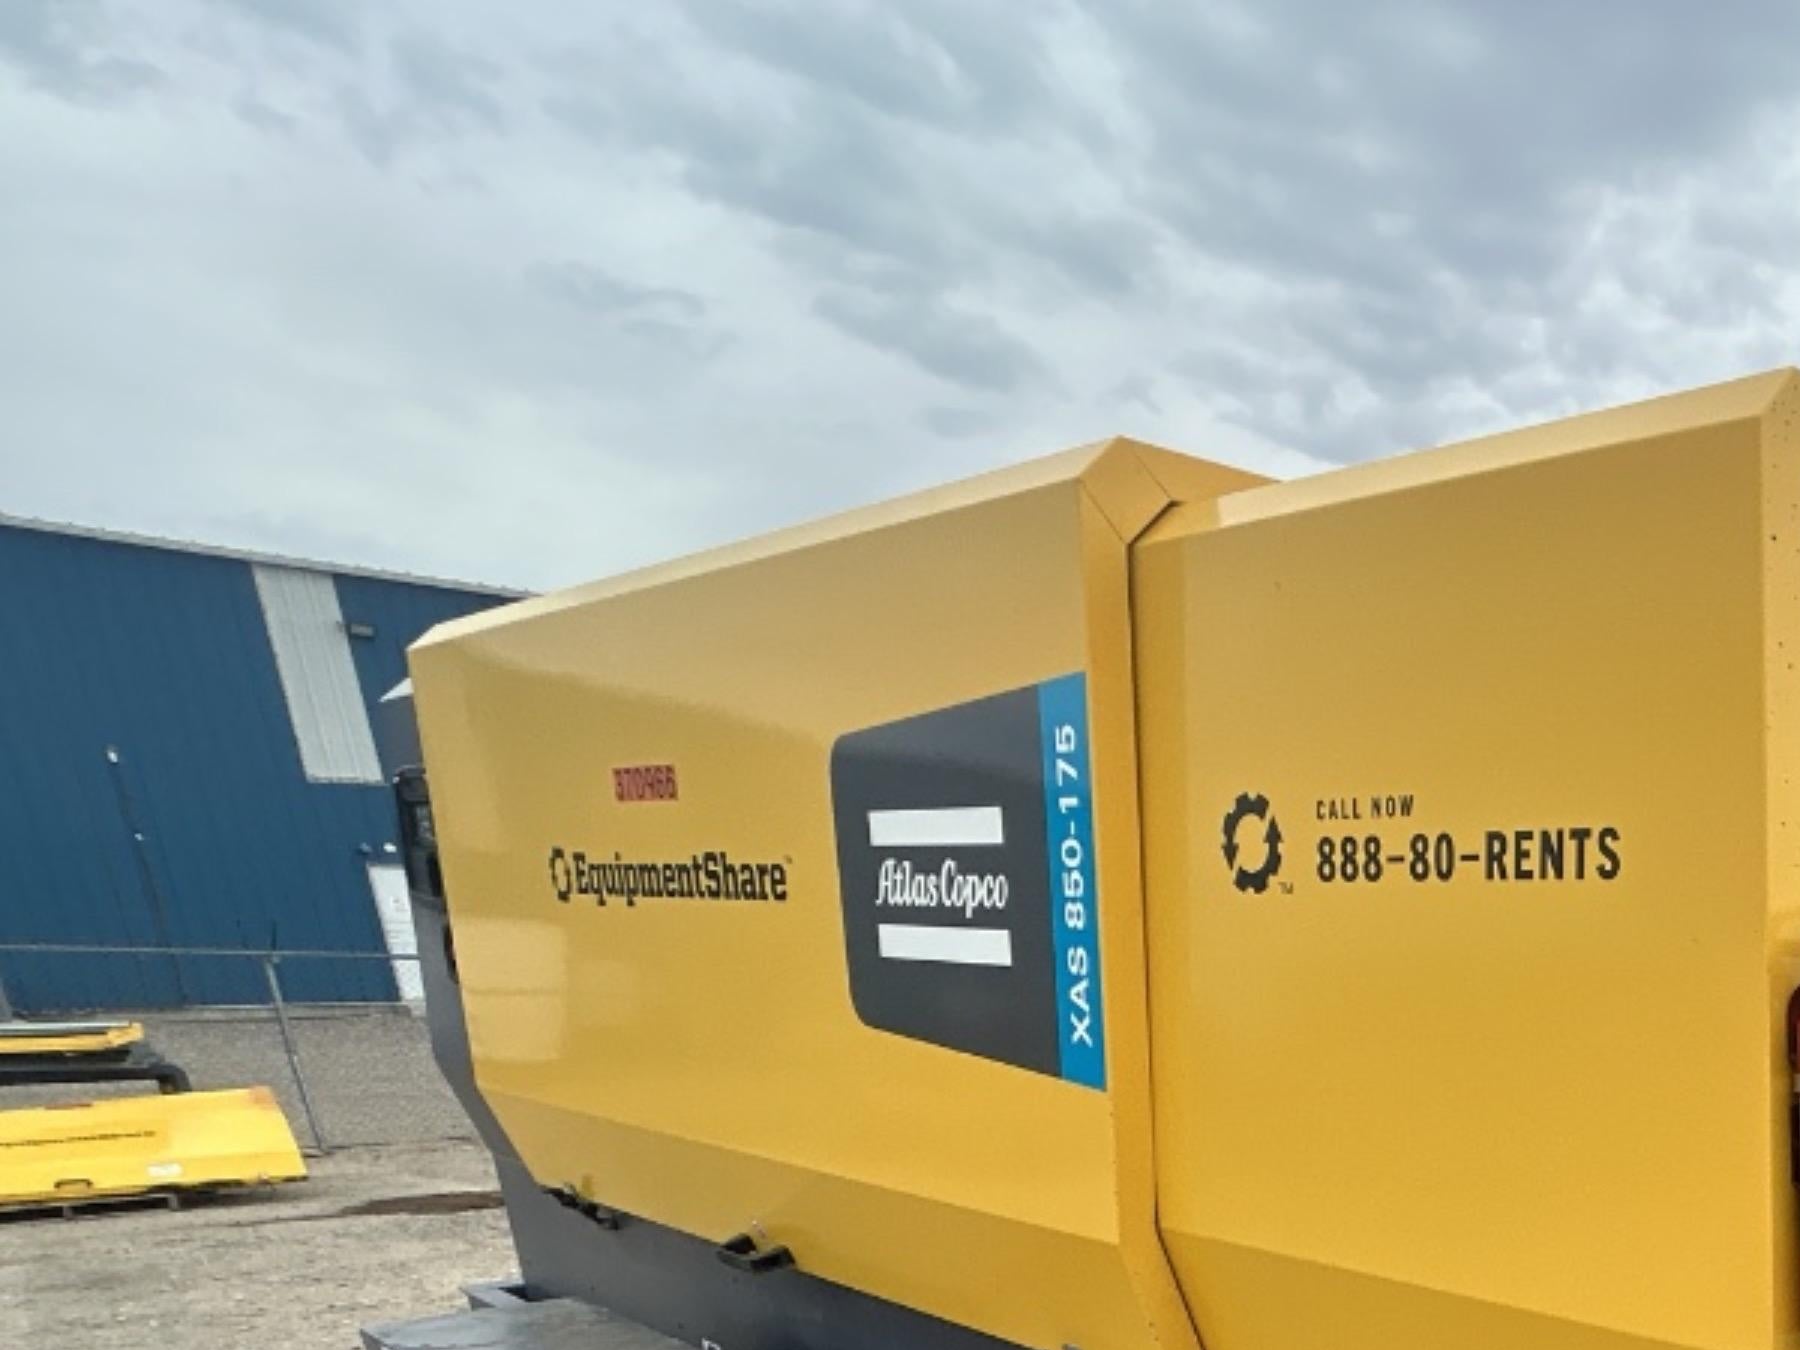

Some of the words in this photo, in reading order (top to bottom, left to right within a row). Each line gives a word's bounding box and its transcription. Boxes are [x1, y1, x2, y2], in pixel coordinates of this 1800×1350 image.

[1056, 725, 1085, 930] 850-175
[1316, 797, 1361, 820] CALL
[1371, 794, 1415, 818] NOW
[572, 850, 787, 907] EquipmentShare
[1316, 827, 1622, 883] 888-80-RENTS
[875, 856, 938, 908] Atlas
[940, 857, 1009, 919] Copco
[1069, 946, 1092, 1047] XAS
